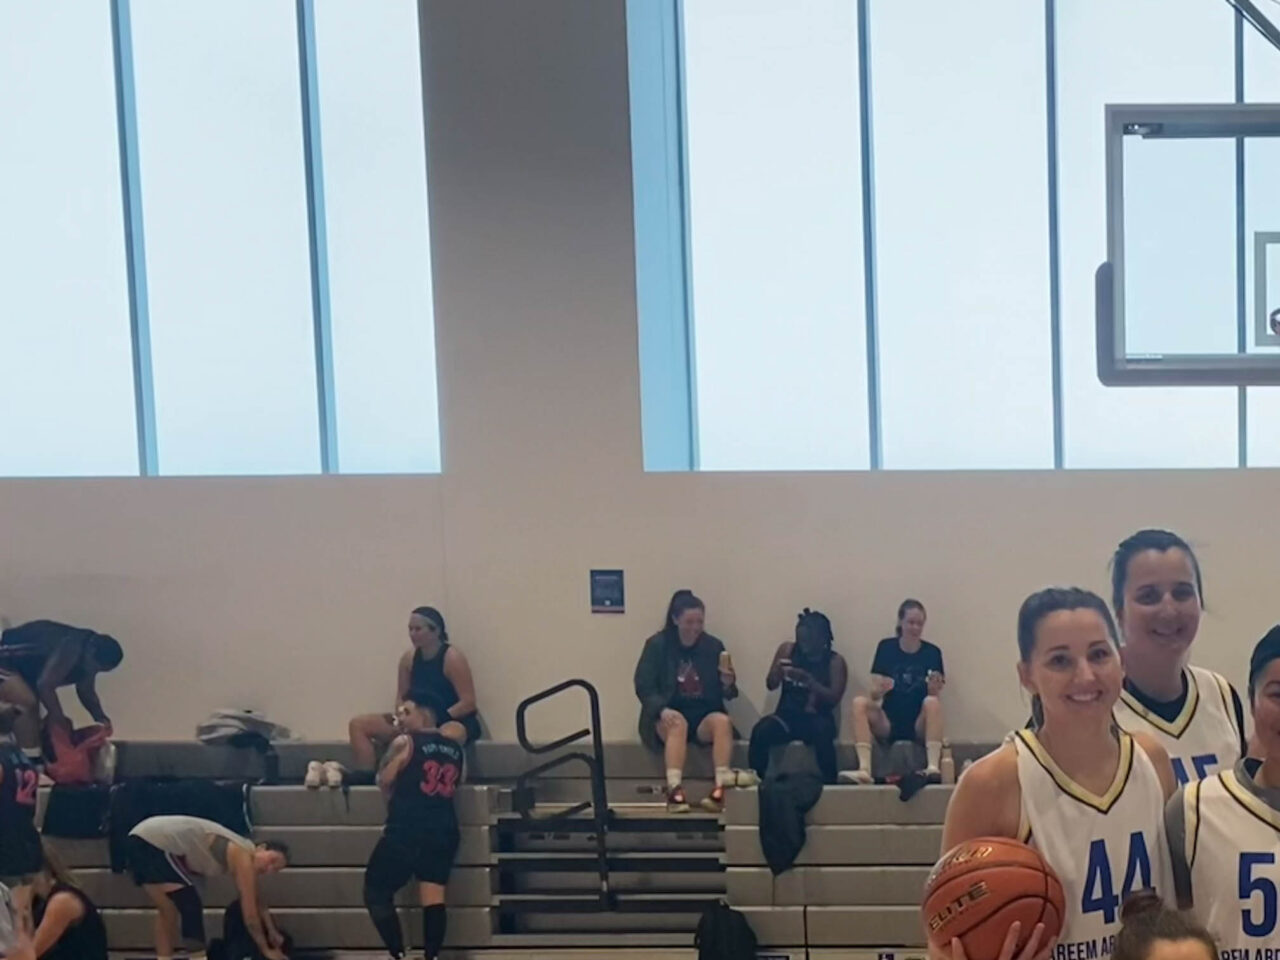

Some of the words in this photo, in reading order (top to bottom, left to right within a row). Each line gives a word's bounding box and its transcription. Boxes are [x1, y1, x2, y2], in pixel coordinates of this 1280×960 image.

[420, 760, 459, 797] 33
[1081, 831, 1152, 925] 44
[929, 881, 990, 933] ELITE
